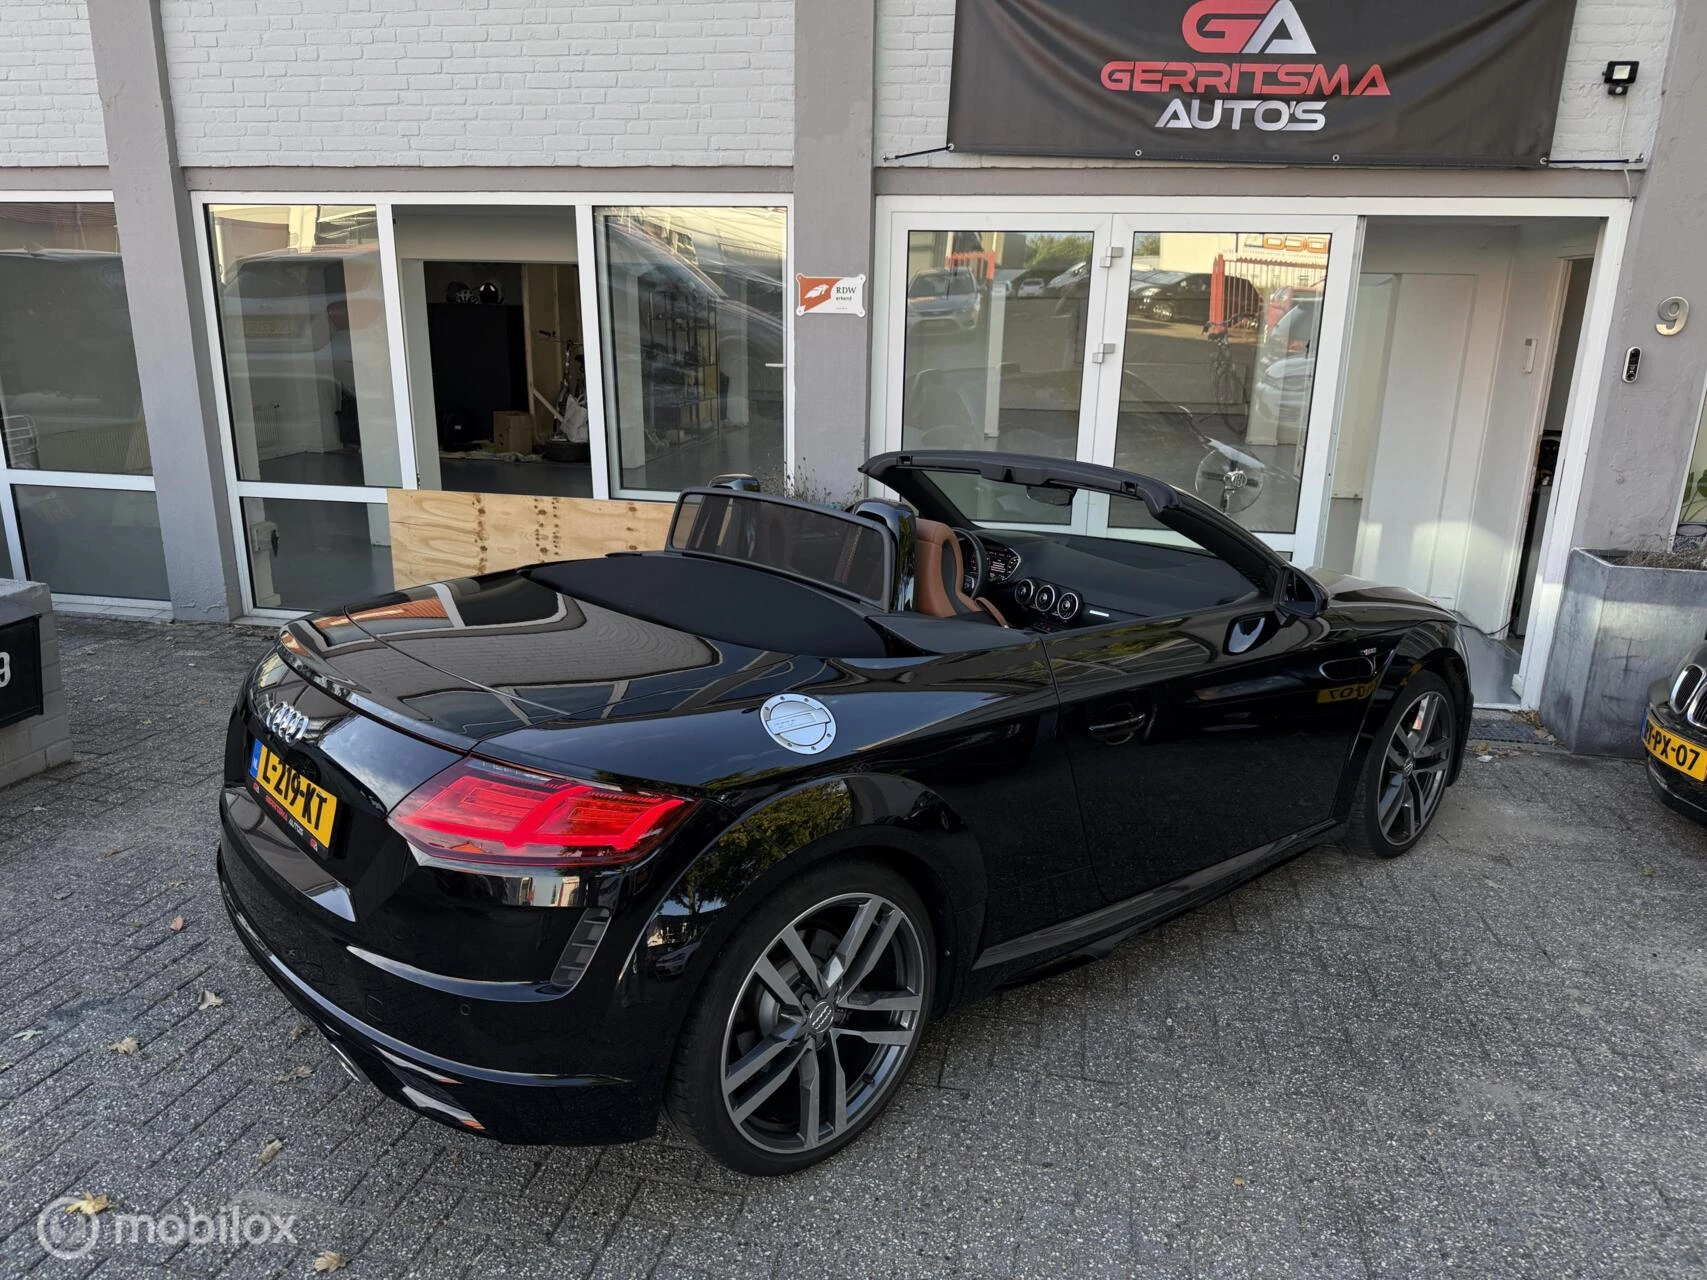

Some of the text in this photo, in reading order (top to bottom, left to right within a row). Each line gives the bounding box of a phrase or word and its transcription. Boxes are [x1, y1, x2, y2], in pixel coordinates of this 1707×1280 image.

[1182, 0, 1317, 54] GA
[1100, 61, 1391, 97] GERRITSMA
[1154, 98, 1327, 131] AUTO'S
[836, 286, 857, 294] RDW
[1655, 296, 1690, 336] 9
[0, 651, 11, 688] 9
[262, 749, 328, 831] L-219-KT
